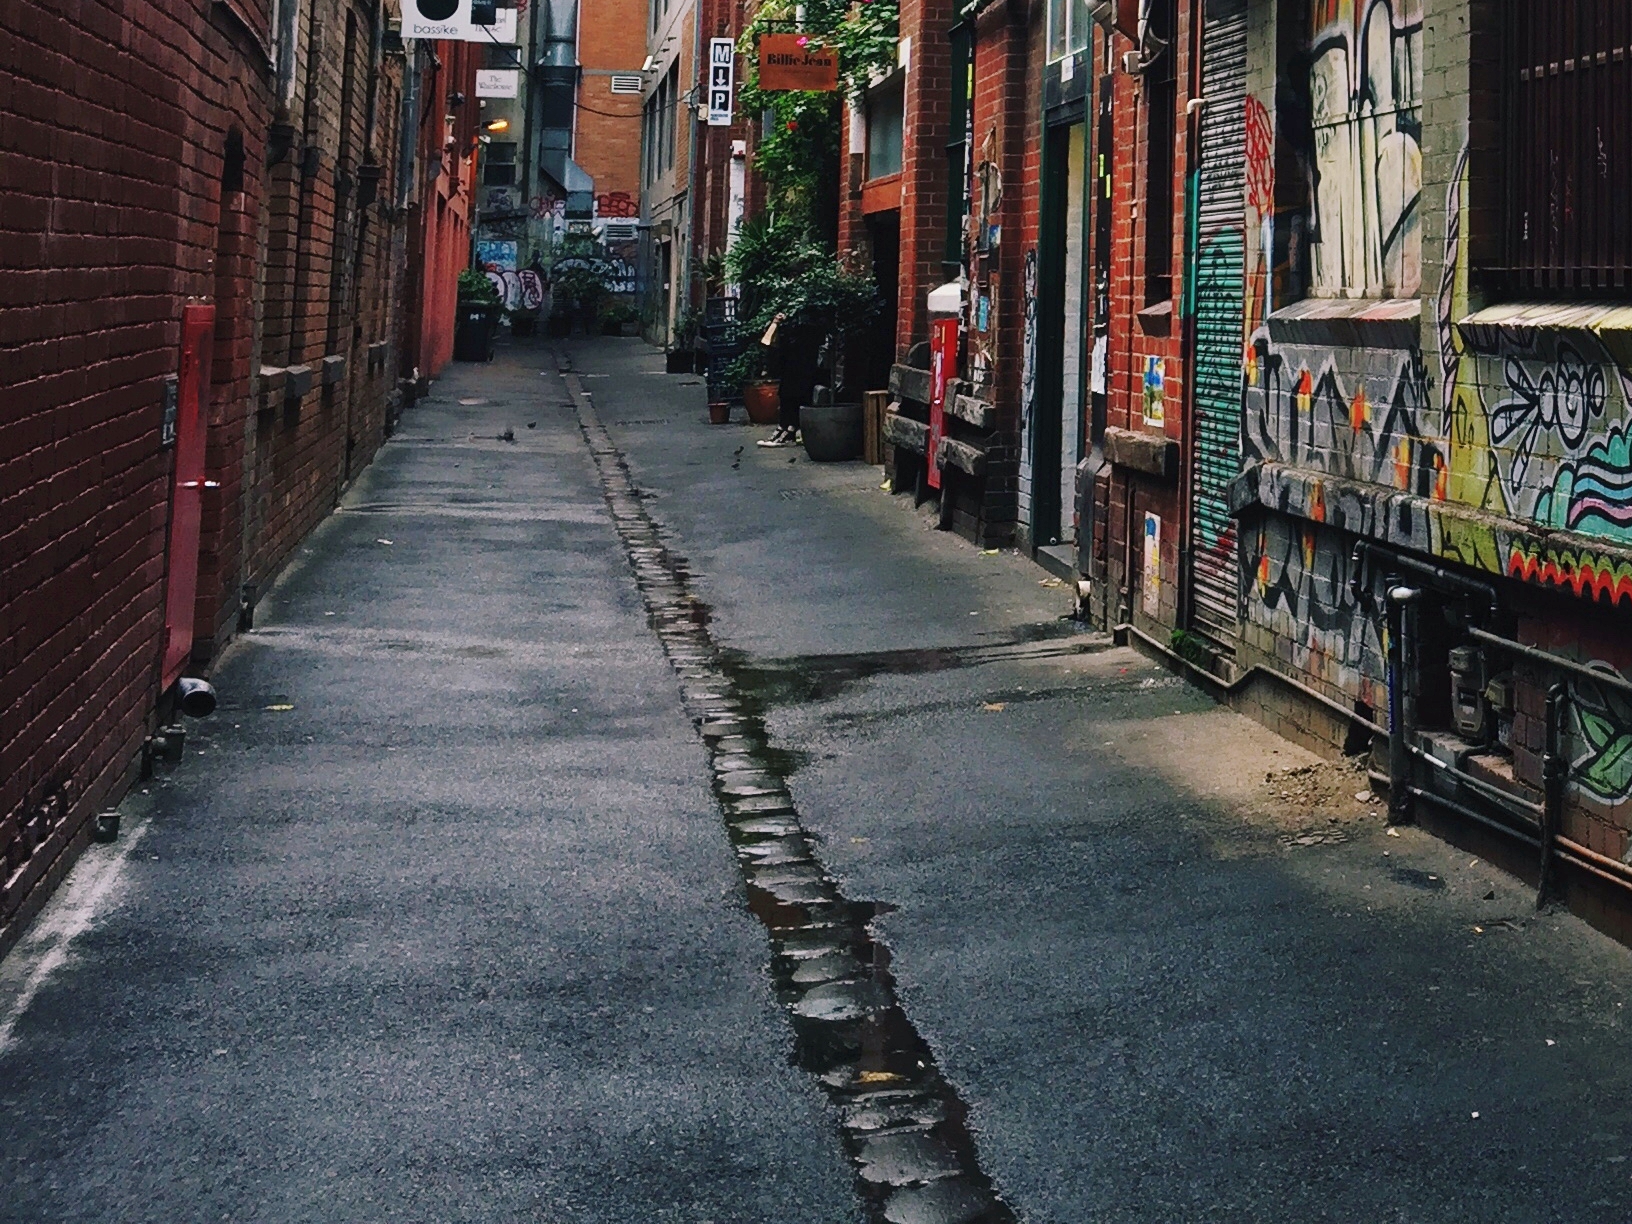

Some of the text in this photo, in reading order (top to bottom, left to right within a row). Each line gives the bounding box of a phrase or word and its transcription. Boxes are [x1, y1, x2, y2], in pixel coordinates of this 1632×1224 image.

[413, 23, 458, 35] bassike
[714, 45, 730, 62] M
[767, 53, 832, 67] Billie Jean
[715, 92, 726, 110] P
